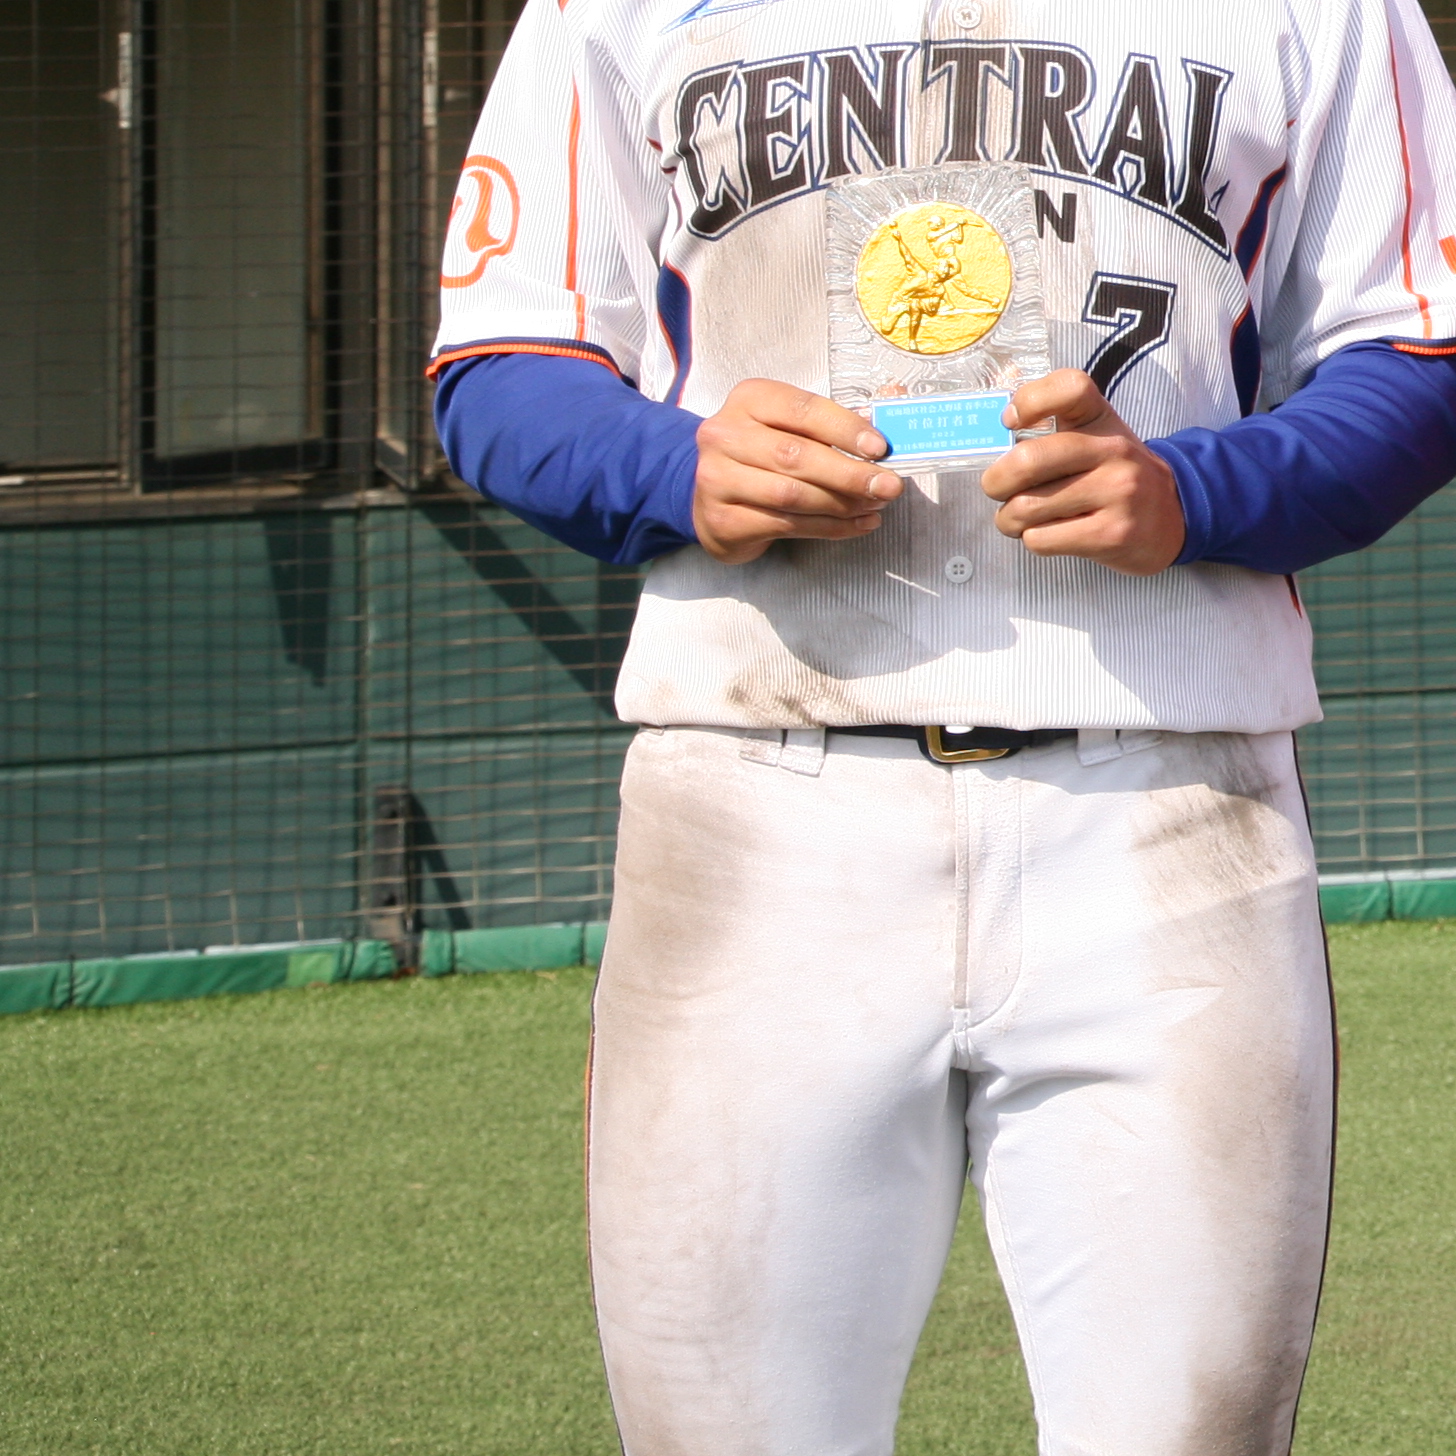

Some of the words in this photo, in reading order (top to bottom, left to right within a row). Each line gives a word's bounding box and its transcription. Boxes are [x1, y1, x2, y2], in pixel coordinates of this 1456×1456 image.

[674, 39, 1235, 262] CENTRAL
[1082, 271, 1178, 402] 7
[907, 414, 979, 430] 首位打者賞
